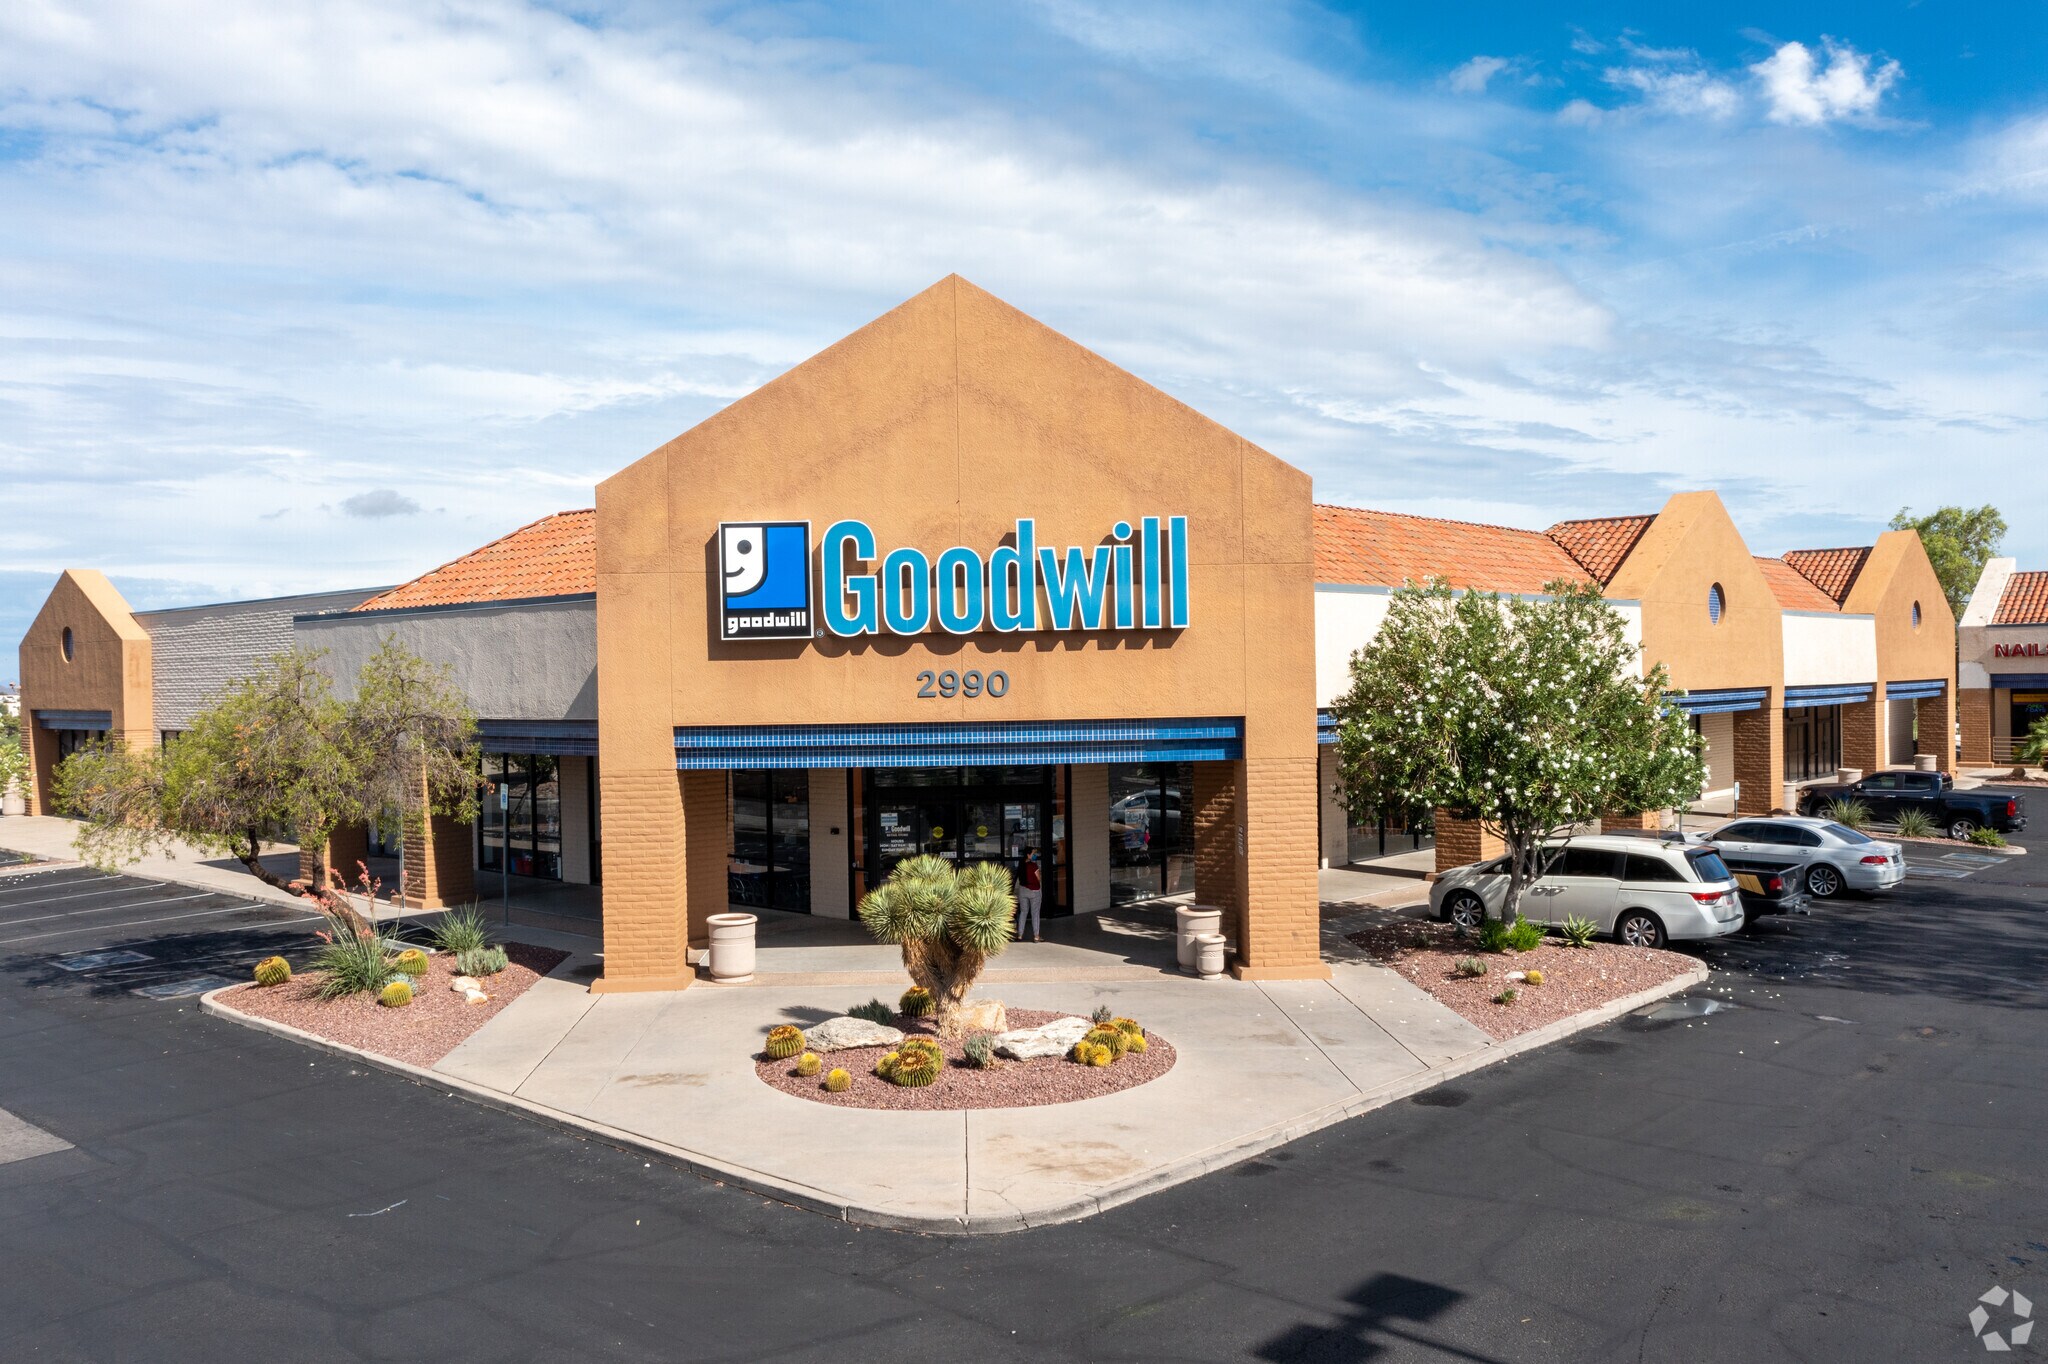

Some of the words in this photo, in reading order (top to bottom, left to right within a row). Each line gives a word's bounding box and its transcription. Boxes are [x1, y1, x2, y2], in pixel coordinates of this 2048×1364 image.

[821, 515, 1189, 638] Goodwill
[727, 611, 806, 634] goodwill
[1994, 642, 2048, 657] NAIL
[916, 669, 1010, 698] 2990
